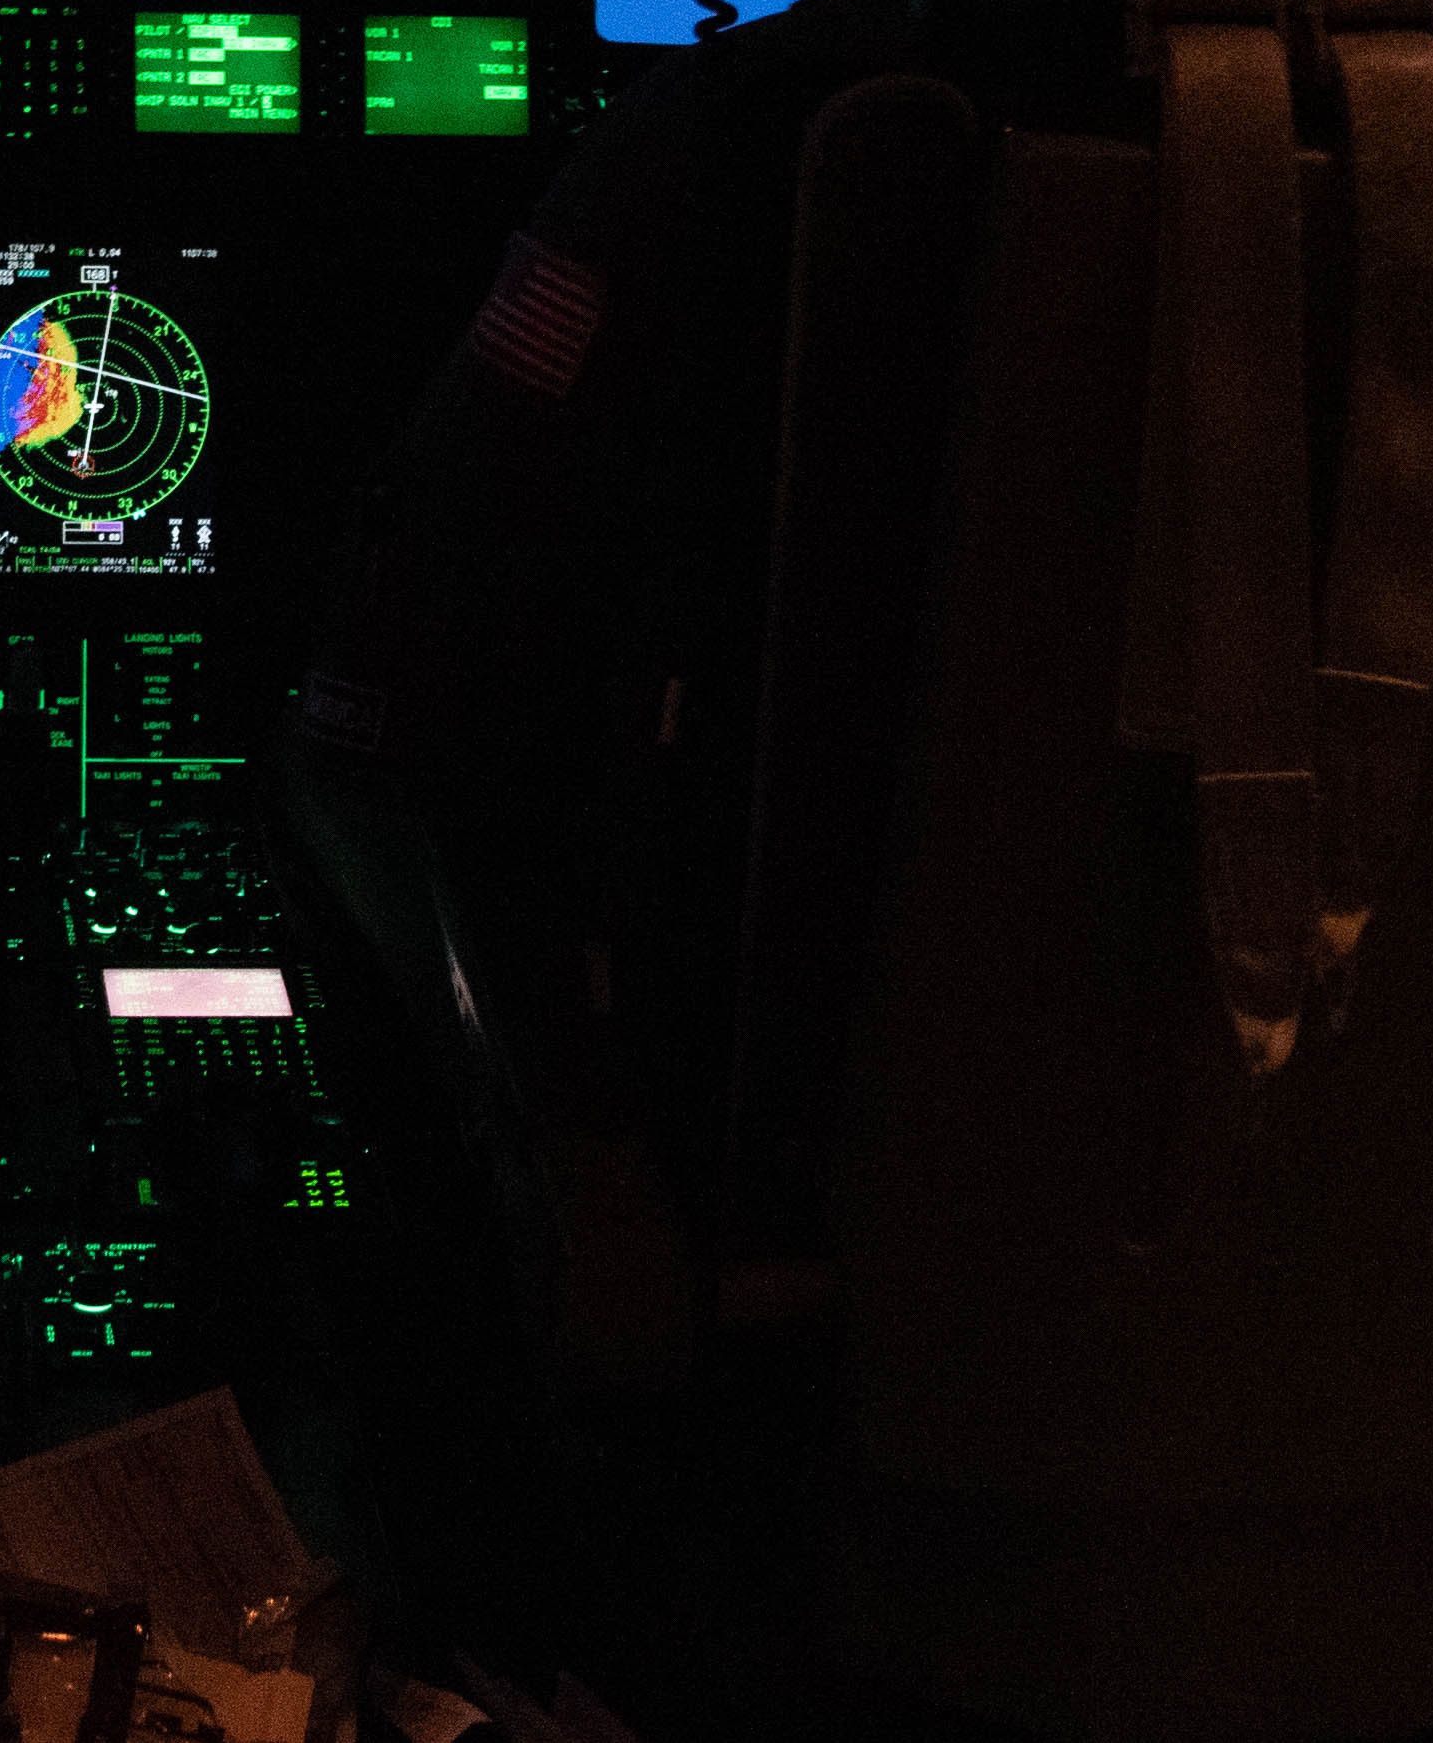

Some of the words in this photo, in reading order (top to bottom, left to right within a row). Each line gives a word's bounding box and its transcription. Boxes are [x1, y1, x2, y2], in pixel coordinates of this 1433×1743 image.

[208, 14, 251, 25] SELECT
[517, 41, 526, 51] 2
[175, 72, 185, 83] 2
[86, 269, 105, 280] 168
[154, 325, 170, 337] 21
[183, 370, 197, 381] 24
[161, 469, 177, 480] 30
[19, 476, 34, 487] 03
[118, 498, 133, 509] 33
[124, 634, 165, 643] LANDING
[169, 634, 202, 643] LIGHTS
[142, 646, 173, 655] MOTORS
[56, 697, 81, 705] RIGHT
[142, 721, 171, 730] LIGHTS
[93, 771, 112, 780] TAXI
[114, 771, 142, 780] LIGHTS
[171, 772, 189, 781] TAXI
[192, 772, 221, 781] LIGHTS
